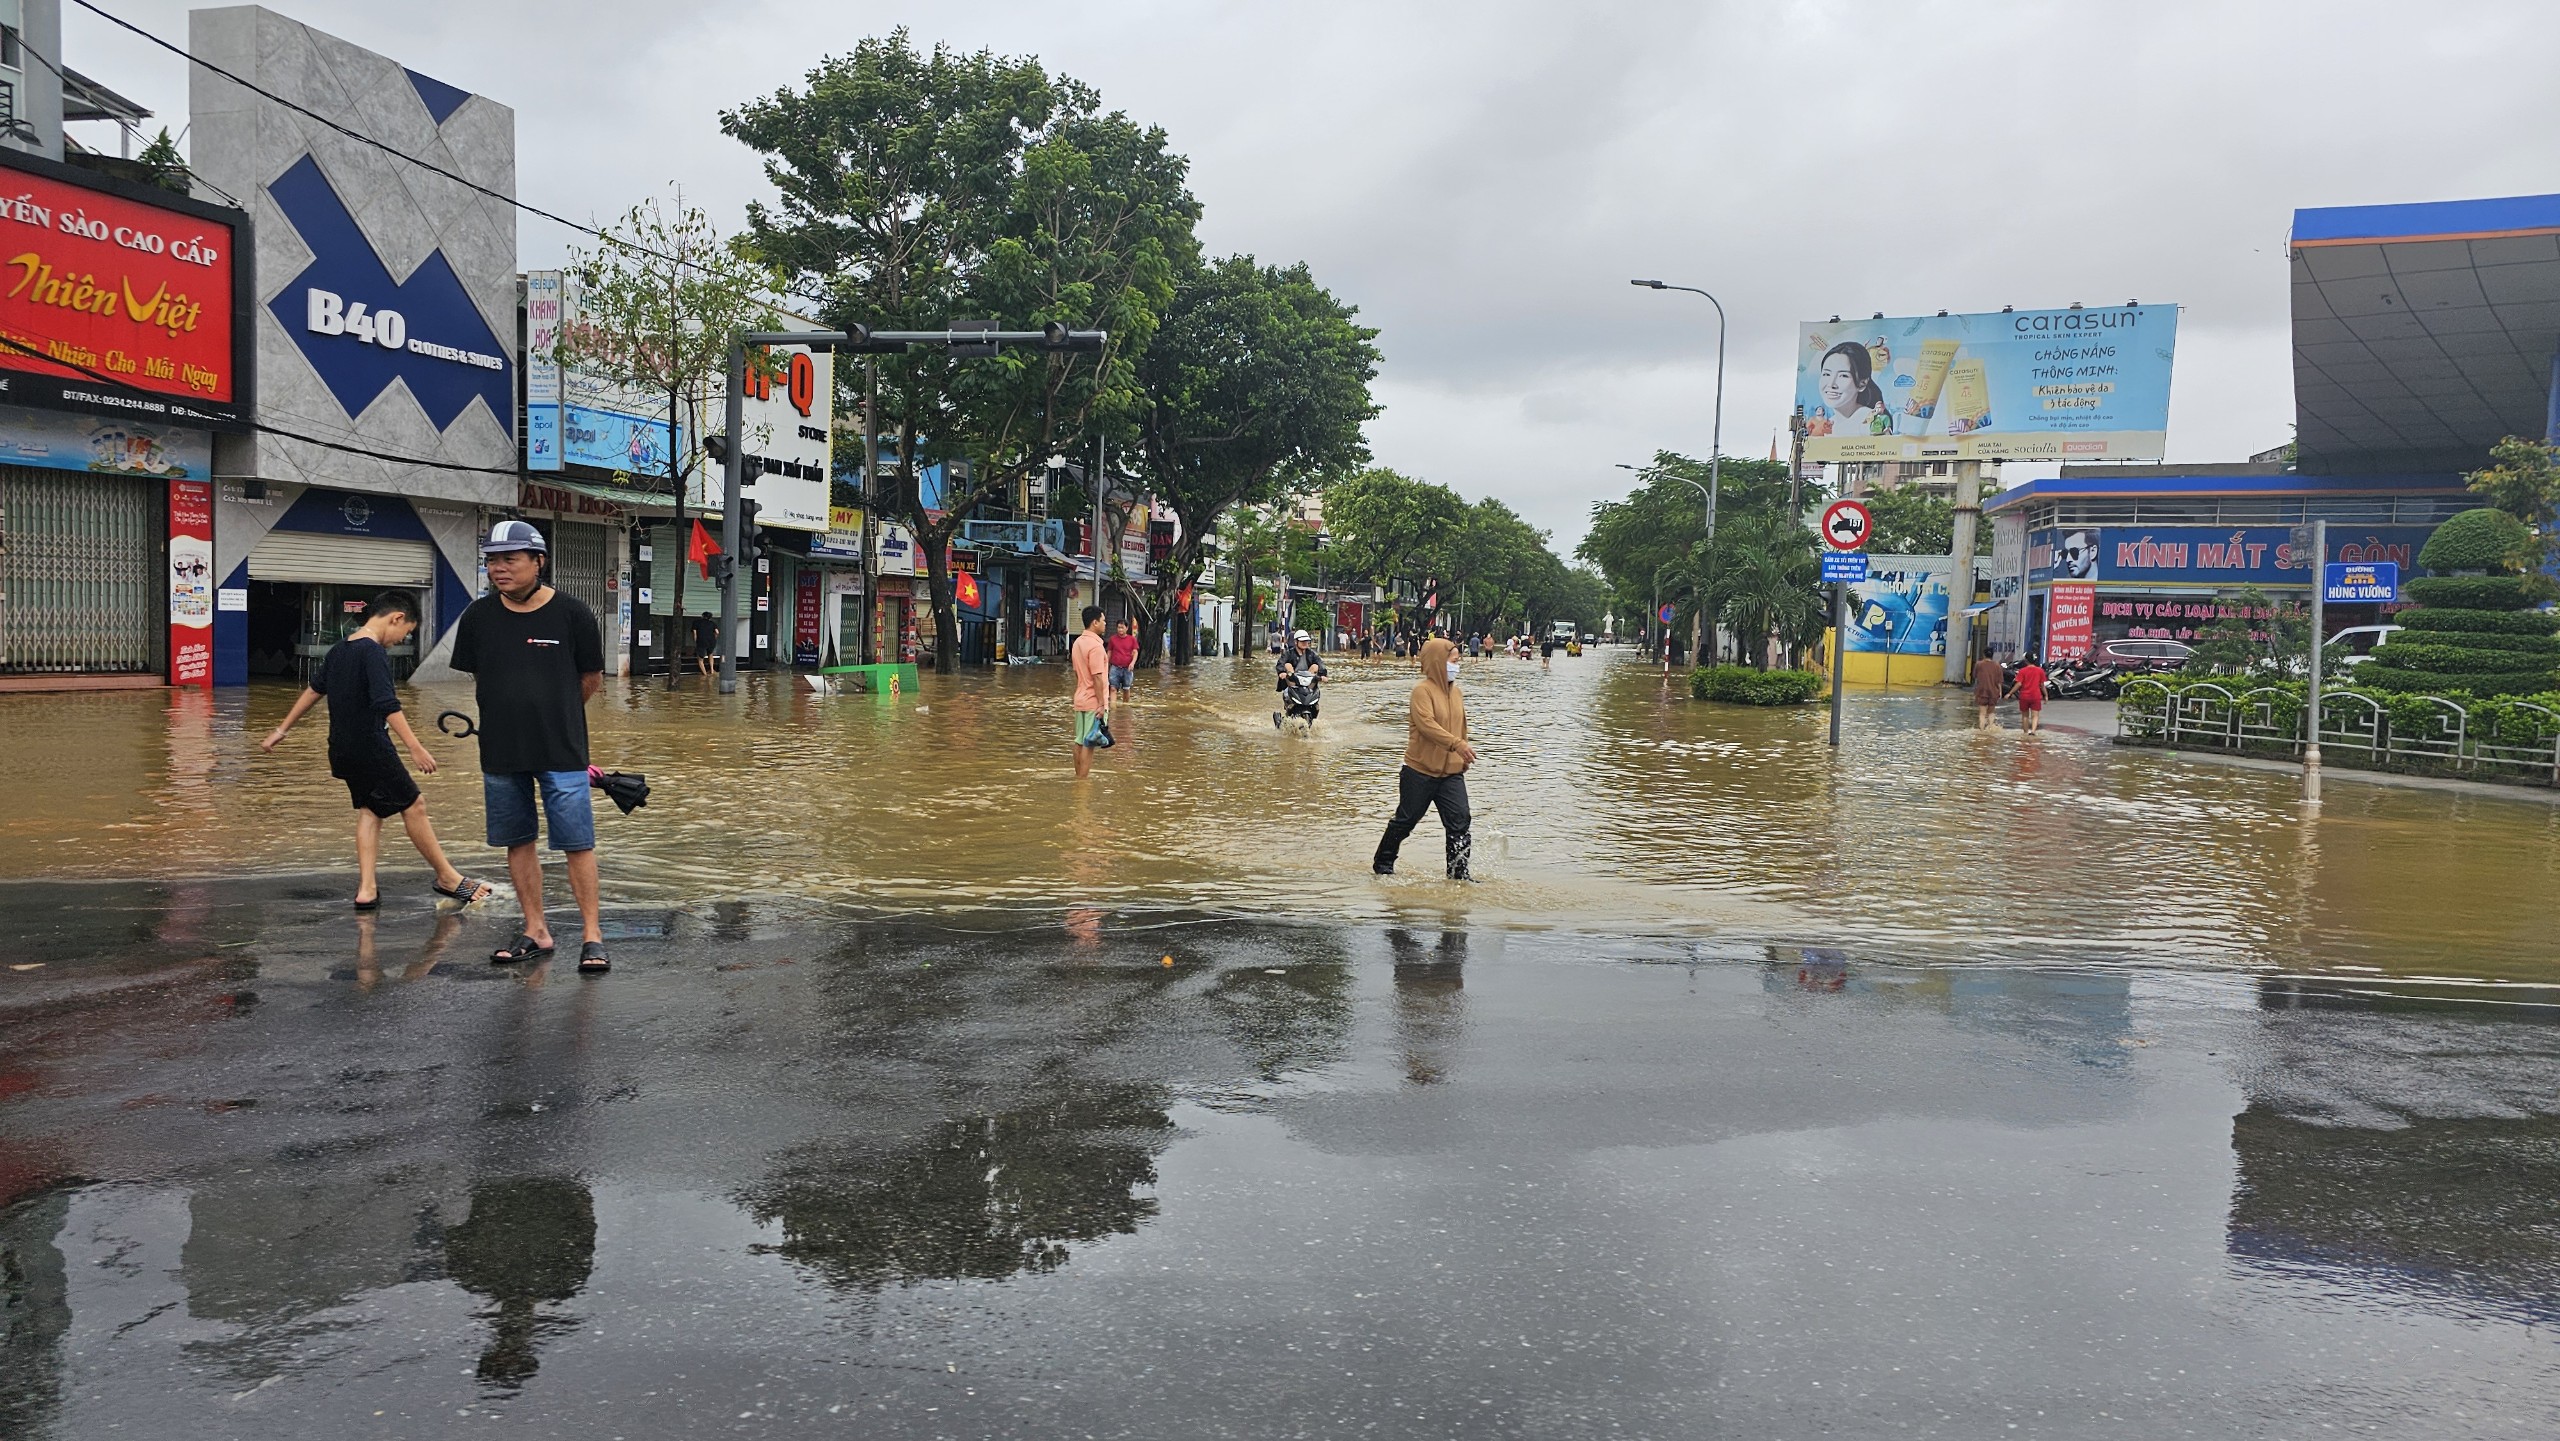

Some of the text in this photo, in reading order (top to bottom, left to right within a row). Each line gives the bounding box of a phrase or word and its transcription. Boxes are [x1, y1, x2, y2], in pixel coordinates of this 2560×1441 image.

[58, 208, 109, 241] SÀO
[114, 227, 165, 254] CAO
[170, 236, 218, 267] CẤP
[8, 253, 202, 338] Thiên Việt
[530, 296, 557, 320] KHÁNH
[308, 288, 503, 370] B40 CLOTHES & SHOES
[2015, 311, 2137, 332] carasun
[2034, 342, 2116, 361] CHỐNG NẮNG
[48, 340, 218, 393] Nhiên Cho Mỗi Ngày
[2032, 364, 2118, 379] THÔNG MINH:
[63, 390, 102, 404] ĐT/FAX:
[2038, 383, 2109, 396] Khiên bảo vệ da
[2057, 398, 2072, 408] tác
[2073, 397, 2096, 411] động
[798, 425, 828, 443] STORE
[2014, 443, 2057, 454] sociolla
[2067, 443, 2103, 453] guardian
[1849, 518, 1861, 528] 15T
[2116, 536, 2189, 568] KÍNH
[2197, 530, 2267, 569] MẮT
[2340, 536, 2410, 570] GÒN
[2345, 565, 2375, 573] ĐƯỜNG
[2328, 584, 2391, 599] HÙNG VƯƠNG
[2057, 602, 2087, 614] CƠN LỐC
[2102, 602, 2133, 619] DỊCH
[2135, 602, 2153, 620] VỤ
[2155, 601, 2181, 617] CÁC
[2185, 605, 2215, 621] LOẠI
[2052, 616, 2077, 631] KHUYẾN
